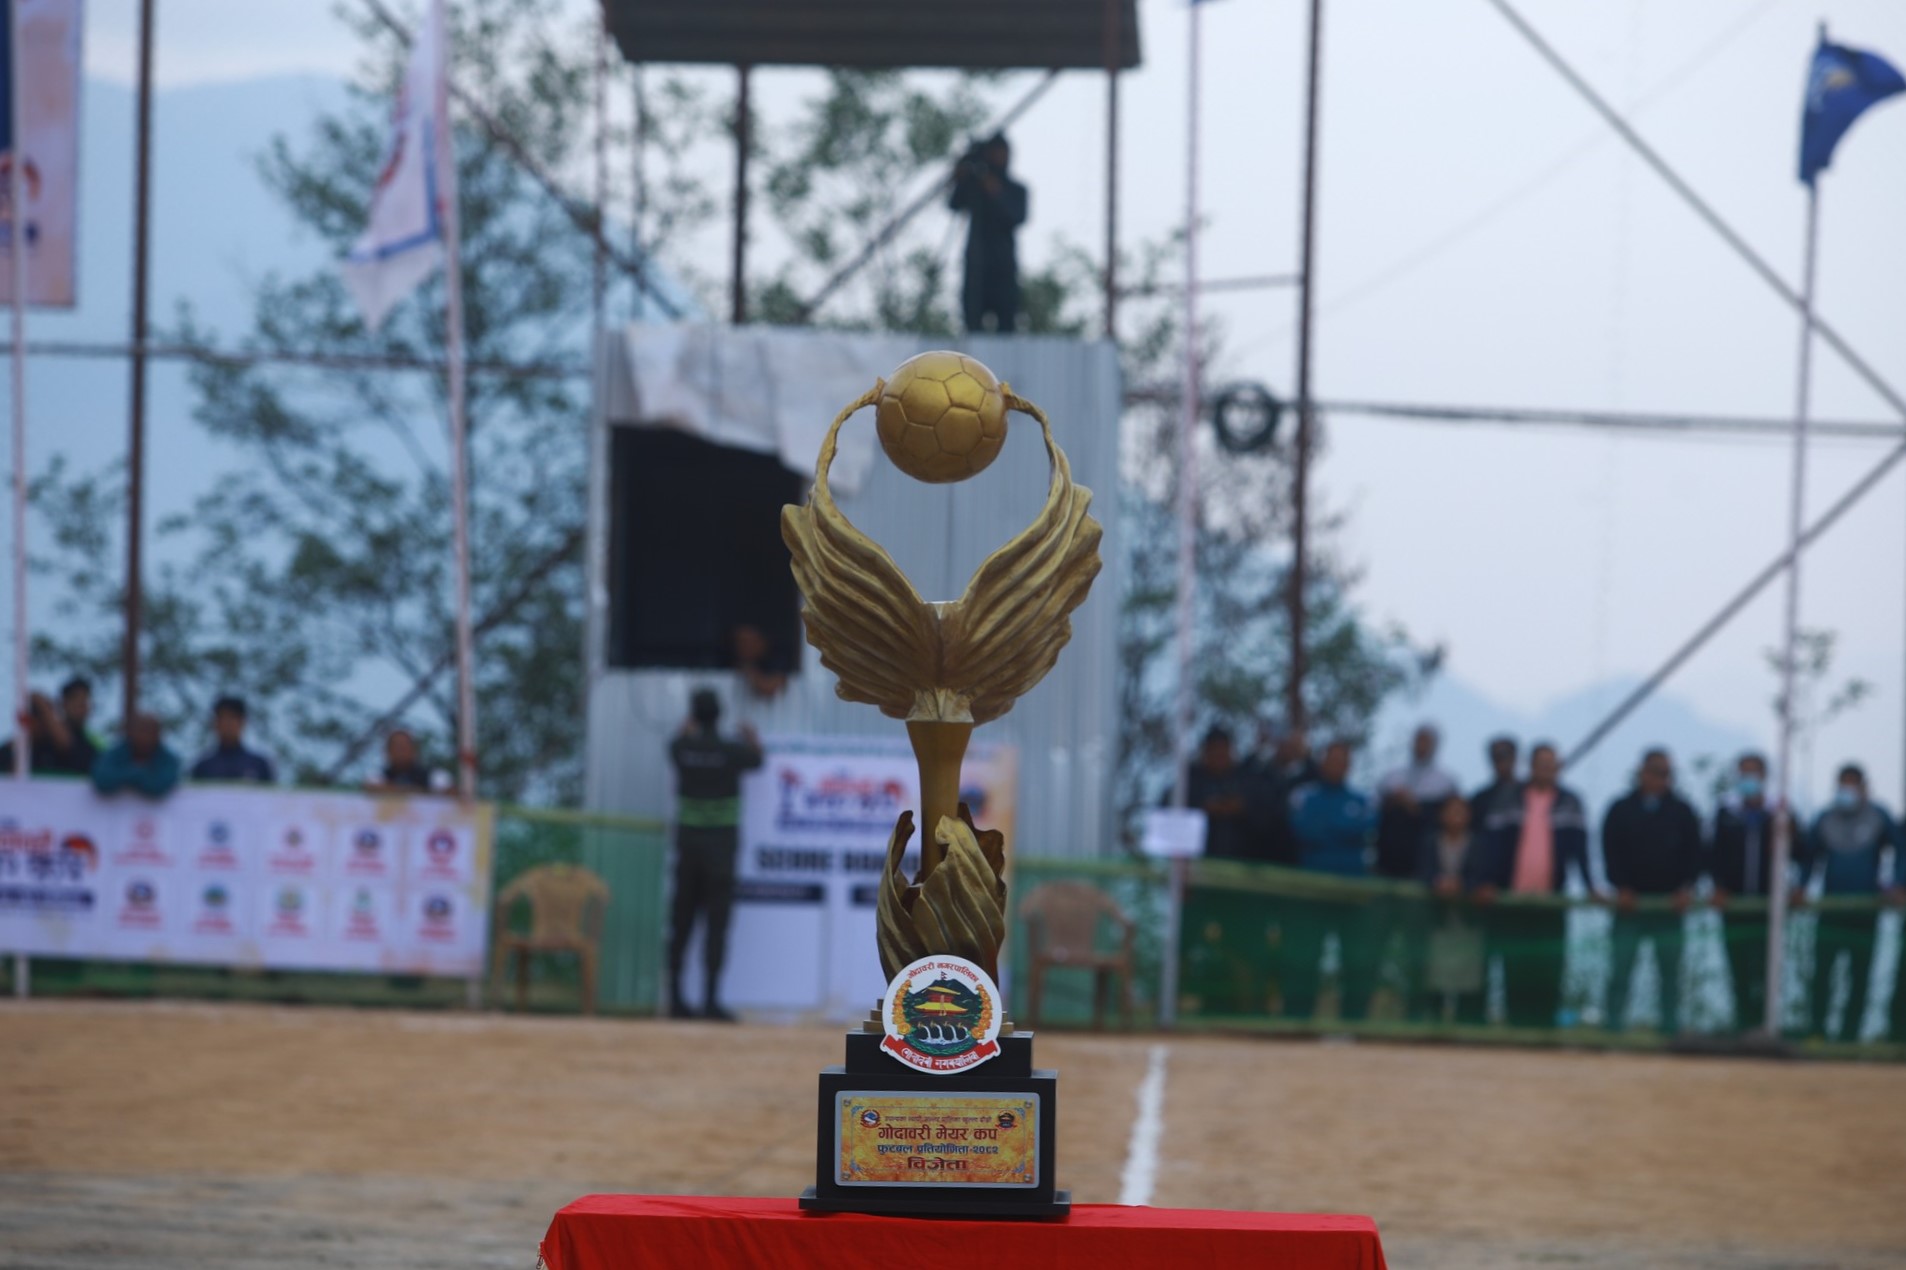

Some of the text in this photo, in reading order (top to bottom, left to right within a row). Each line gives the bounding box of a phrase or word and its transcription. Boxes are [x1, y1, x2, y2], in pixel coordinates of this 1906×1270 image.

[878, 1124, 998, 1140] गोदावरी मेयर कप
[877, 1144, 912, 1155] फुटबल
[907, 1156, 967, 1170] विजेता
